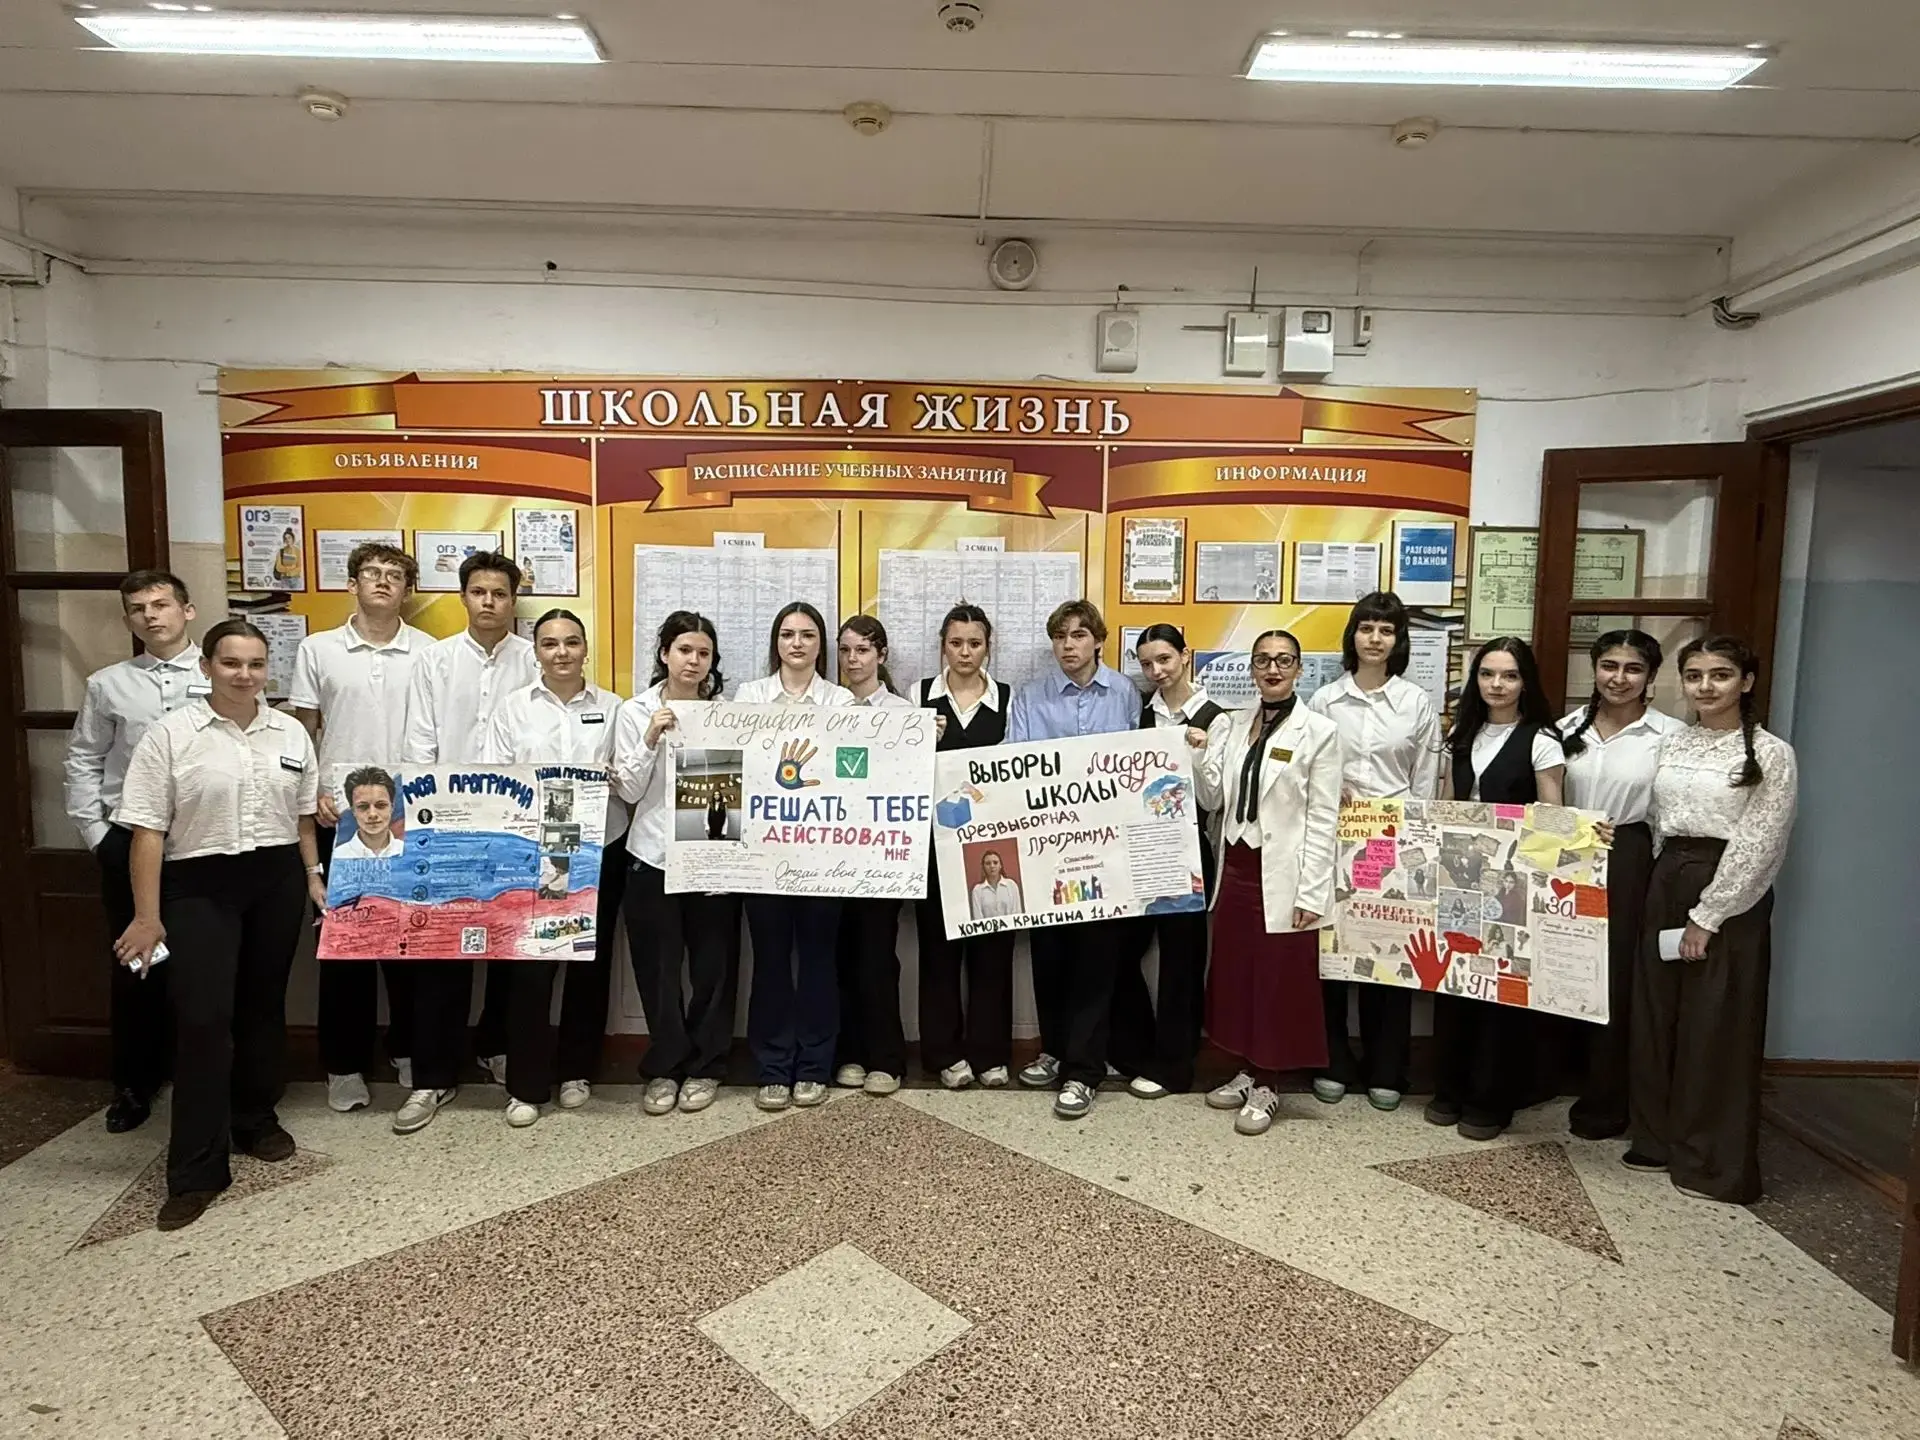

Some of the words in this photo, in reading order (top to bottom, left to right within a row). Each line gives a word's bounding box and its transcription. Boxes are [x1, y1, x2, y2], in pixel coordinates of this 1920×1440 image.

[540, 389, 889, 428] ШКОЛЬНАЯ
[912, 394, 1131, 435] ЖИЗНЬ
[335, 453, 479, 470] ОБЪЯВЛЕНИЯ
[693, 463, 821, 481] РАСПИСАНИЕ
[825, 463, 914, 480] УЧЕБНЫХ
[918, 465, 1008, 486] ЗАНЯТИЙ
[1215, 465, 1368, 484] ИНФОРМАЦИЯ
[245, 510, 271, 522] ОГЭ
[437, 545, 457, 554] ОГЭ
[1405, 545, 1448, 555] РАЗГОВОРЫ
[1405, 556, 1411, 566] О
[1412, 556, 1448, 566] ВАЖНОМ
[703, 702, 815, 750] Кандидат
[826, 711, 860, 732] от
[884, 711, 925, 750] В
[968, 751, 1061, 785] ВЫБОРЫ
[402, 773, 437, 805] МОЯ
[449, 772, 535, 810] ПРОГРАММА
[1026, 778, 1119, 811] ШКОЛЫ
[750, 795, 847, 822] РЕШАТЬ
[866, 795, 930, 822] ТЕБЕ
[1338, 814, 1399, 828] зидента
[762, 825, 913, 846] ДЕЙСТВОВАТЬ
[884, 848, 911, 861] МНЕ
[824, 860, 858, 878] свой
[957, 918, 1009, 937] ХОМОВА
[1013, 908, 1084, 928] КРИСТИНА
